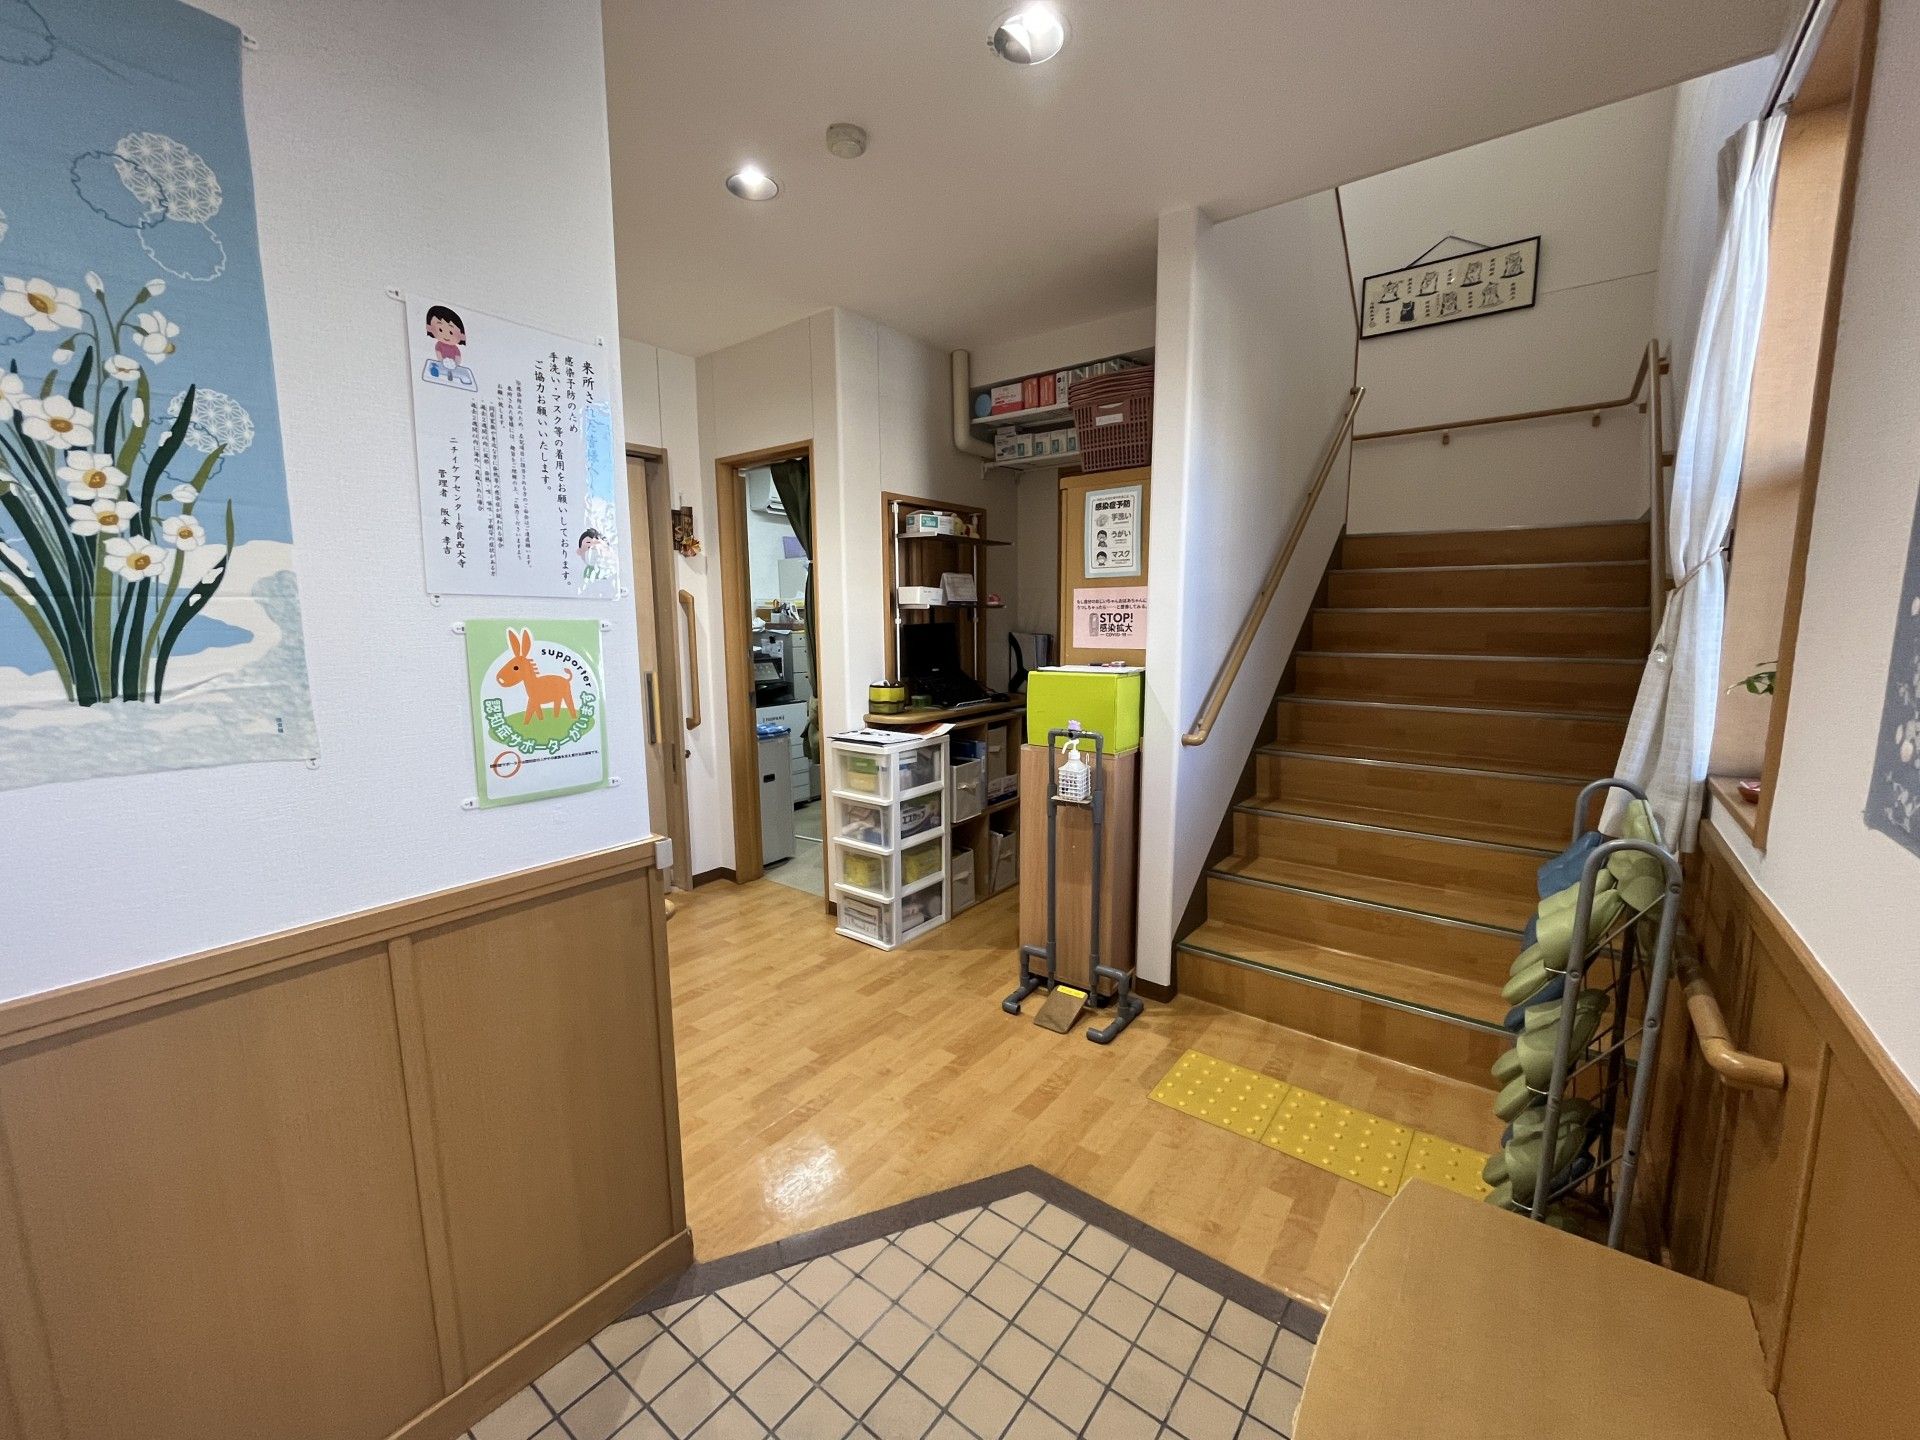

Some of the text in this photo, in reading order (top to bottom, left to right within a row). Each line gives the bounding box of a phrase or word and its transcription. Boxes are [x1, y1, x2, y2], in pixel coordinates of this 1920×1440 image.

[565, 355, 578, 433] 感染予防のため
[535, 360, 552, 491] ご協力お願いいたします。
[438, 468, 449, 497] 管理者
[549, 351, 572, 586] 手洗い・マスク等の着用をお願いしております。
[449, 437, 466, 568] ニチイケアセンター奈良西大寺
[1095, 500, 1130, 511] 感染症予防
[1111, 512, 1132, 521] 手洗い
[1111, 530, 1132, 538] うがい
[1111, 550, 1130, 558] マスク
[1100, 612, 1133, 623] STOP!
[1100, 622, 1133, 633] 感染拡大
[541, 648, 592, 688] supporter
[483, 691, 596, 754] 認知症サポーターがいます
